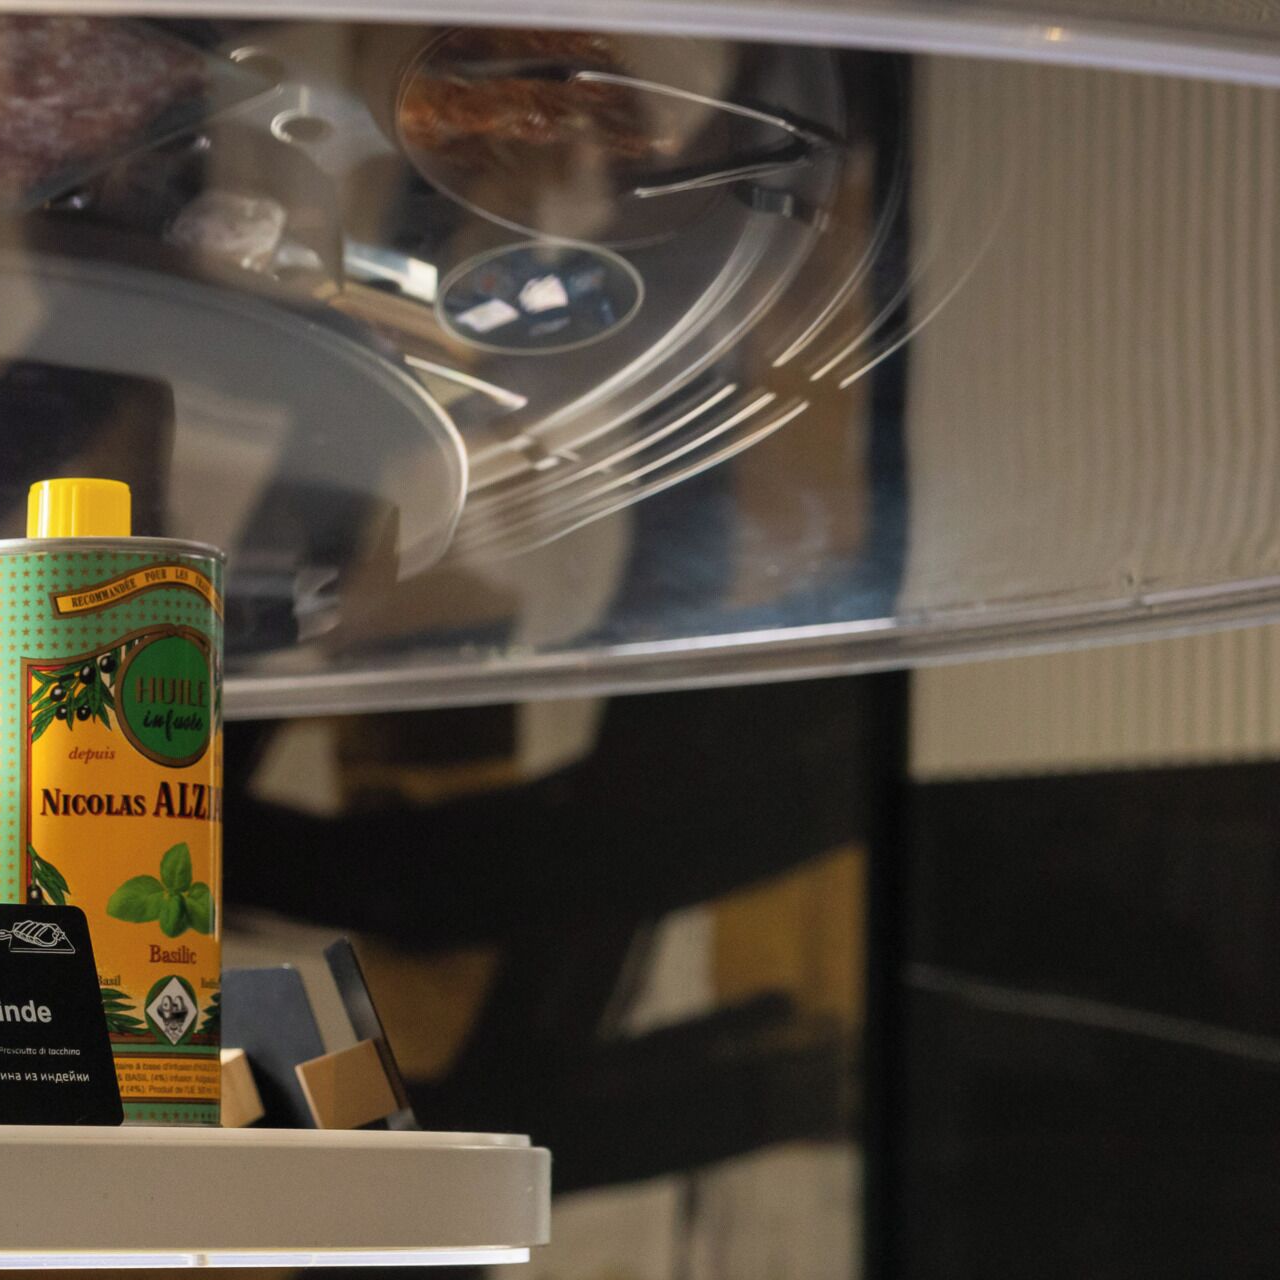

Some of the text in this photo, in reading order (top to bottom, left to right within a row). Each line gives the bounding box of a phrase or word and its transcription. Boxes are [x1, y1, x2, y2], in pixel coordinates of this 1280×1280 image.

[136, 677, 207, 707] HUILE
[68, 746, 115, 764] depuis
[149, 944, 197, 965] Basilic
[25, 1072, 37, 1081] из
[40, 1070, 90, 1083] индейки
